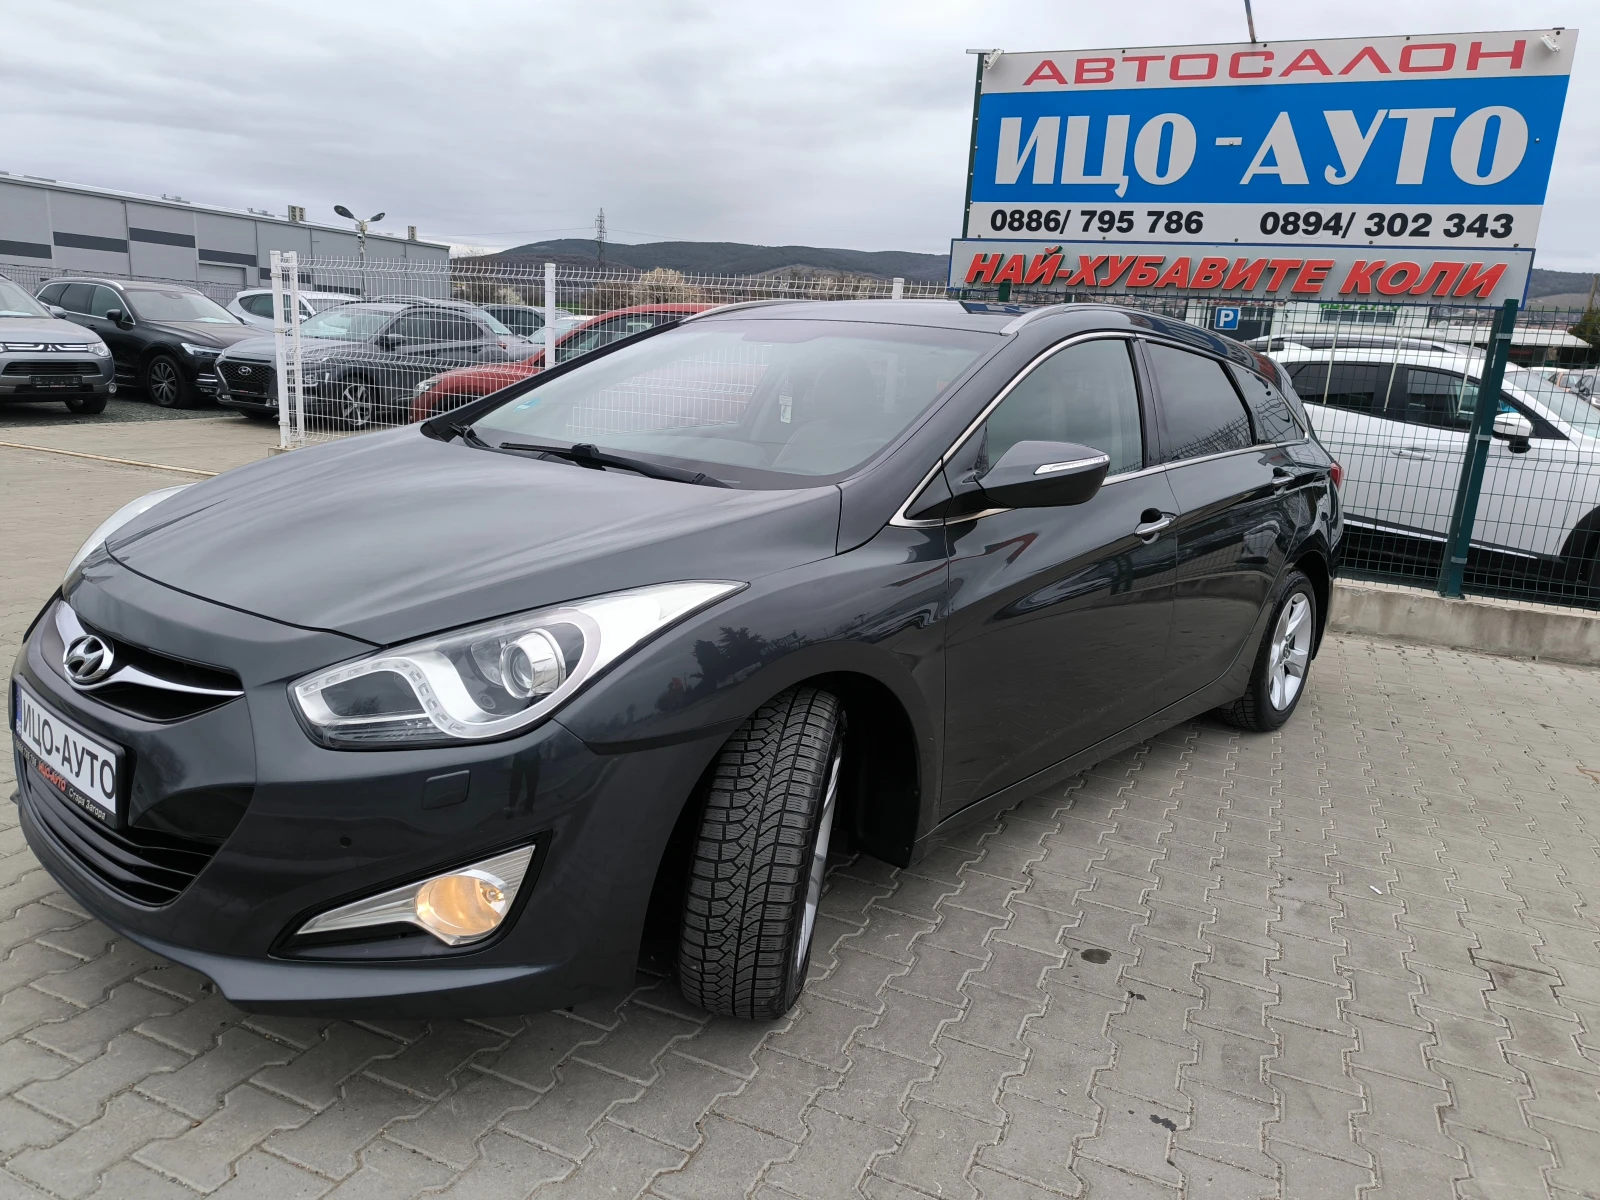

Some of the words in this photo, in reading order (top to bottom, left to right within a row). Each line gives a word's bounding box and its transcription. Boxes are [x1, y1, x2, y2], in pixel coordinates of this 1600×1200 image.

[1024, 39, 1527, 86] АВТОСАЛОН
[990, 209, 1072, 235] 0886/
[1080, 210, 1135, 234] 795
[1146, 210, 1204, 235] 786
[1259, 211, 1357, 239] 0894/
[1364, 212, 1433, 238] 302
[1443, 212, 1514, 239] 343
[964, 246, 1335, 293] НАЙ-ХУБАВИТЕ
[1340, 260, 1508, 298] КОЛИ
[1219, 310, 1235, 327] P
[22, 699, 116, 800] ИЦО-АУТО
[85, 800, 106, 820] Загора
